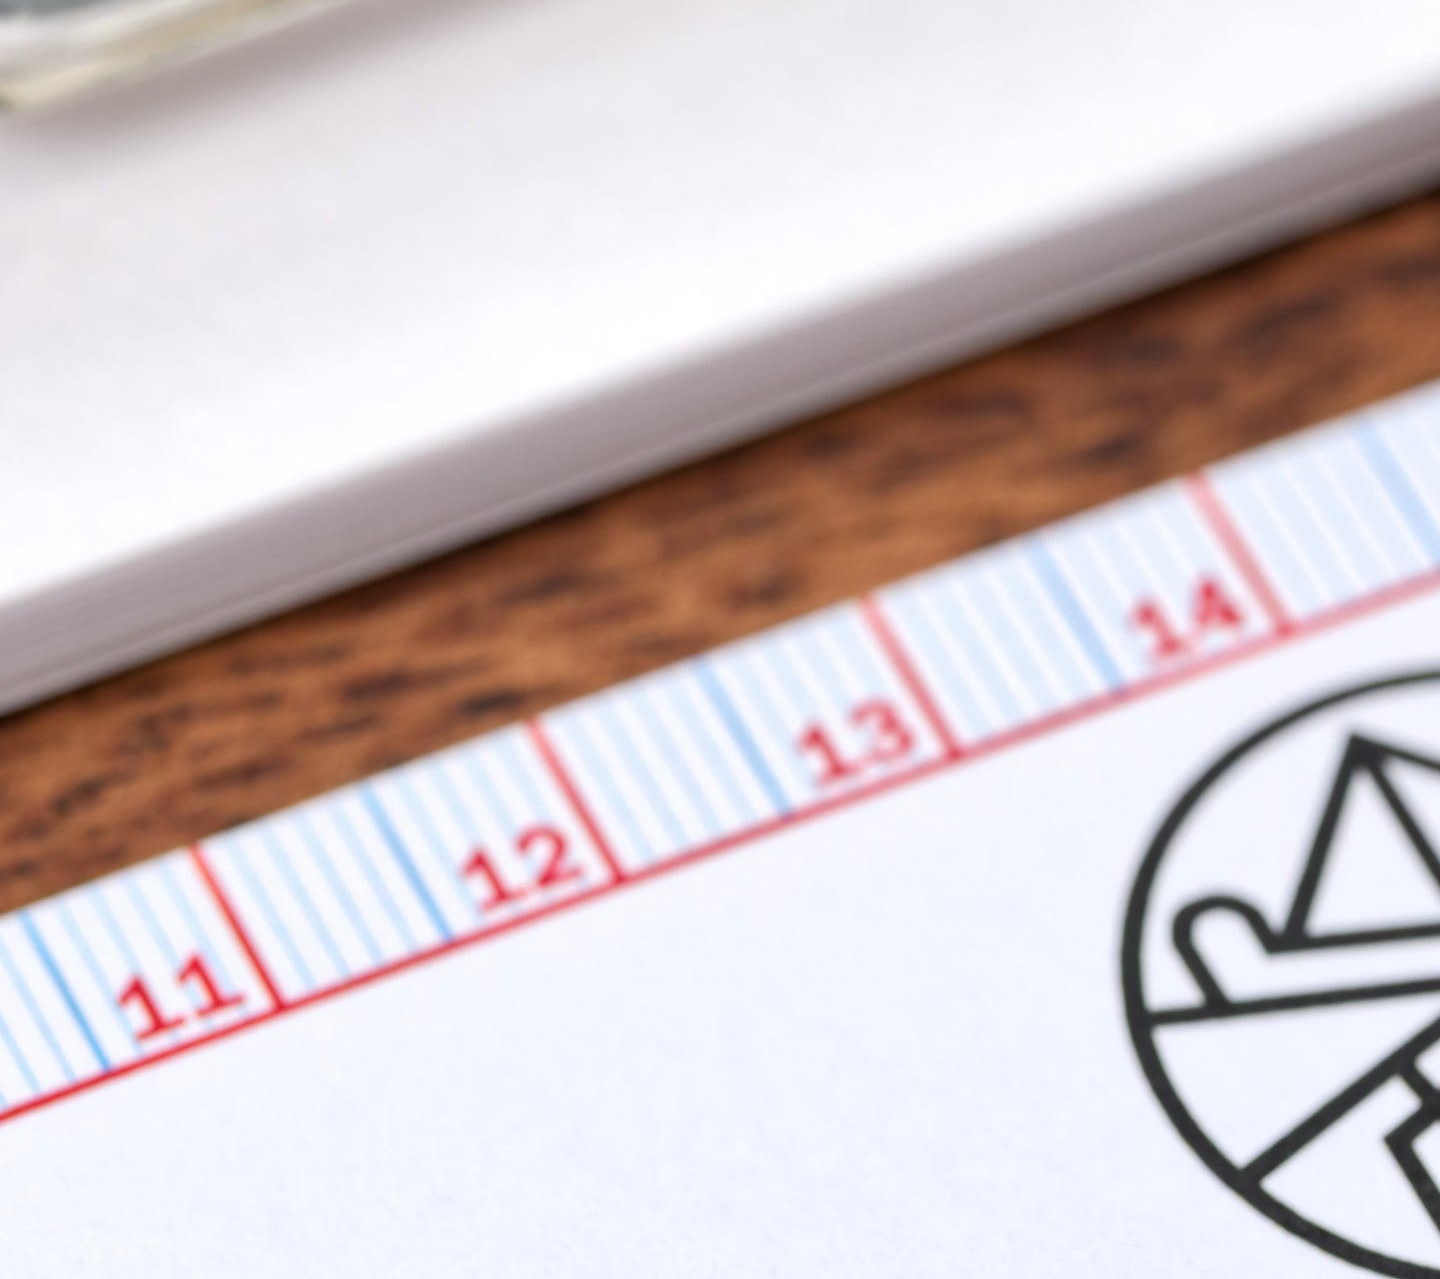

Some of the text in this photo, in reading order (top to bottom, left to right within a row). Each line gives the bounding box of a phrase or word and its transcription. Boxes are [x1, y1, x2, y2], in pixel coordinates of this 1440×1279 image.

[118, 952, 245, 1044] 11
[458, 822, 588, 916] 12
[792, 700, 916, 788] 13
[1130, 576, 1250, 668] 14
